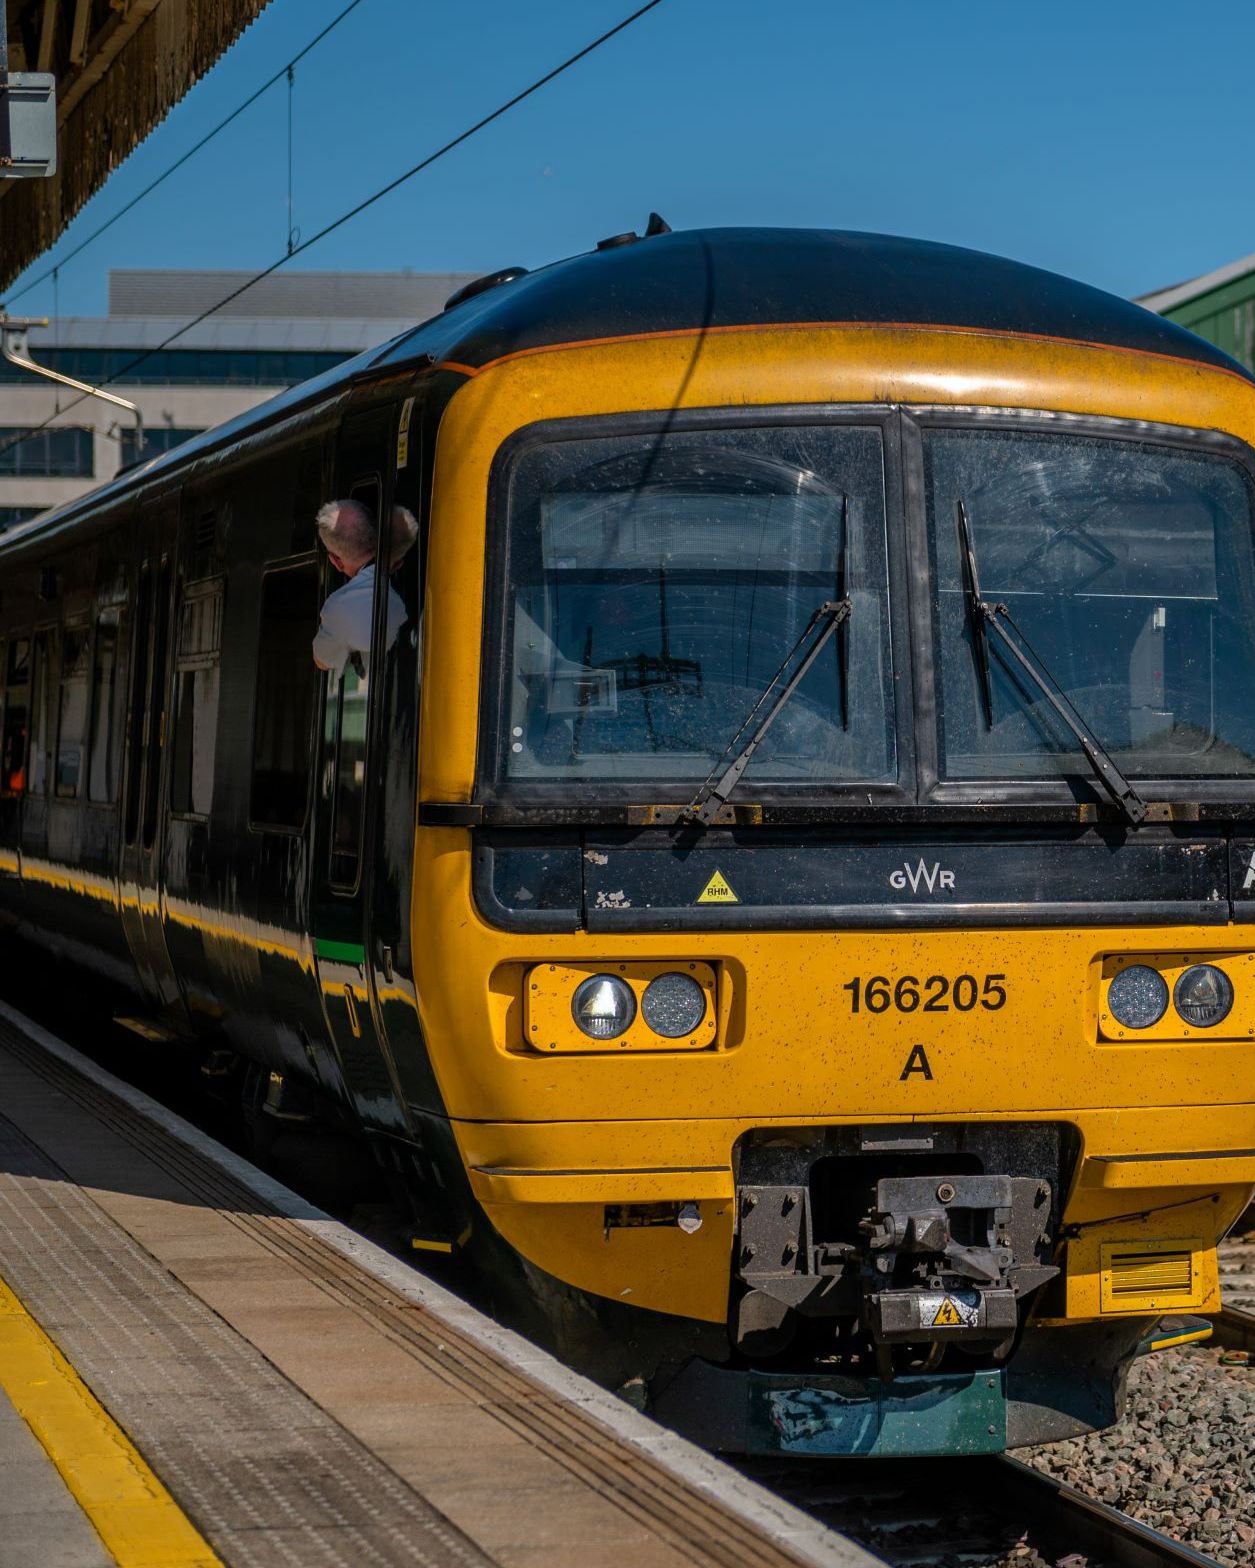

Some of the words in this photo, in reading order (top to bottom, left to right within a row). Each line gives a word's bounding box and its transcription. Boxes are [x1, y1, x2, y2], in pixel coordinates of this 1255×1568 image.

[707, 888, 729, 896] RHM
[889, 857, 956, 894] GWR
[843, 974, 1007, 1013] 166205
[899, 1044, 934, 1081] A
